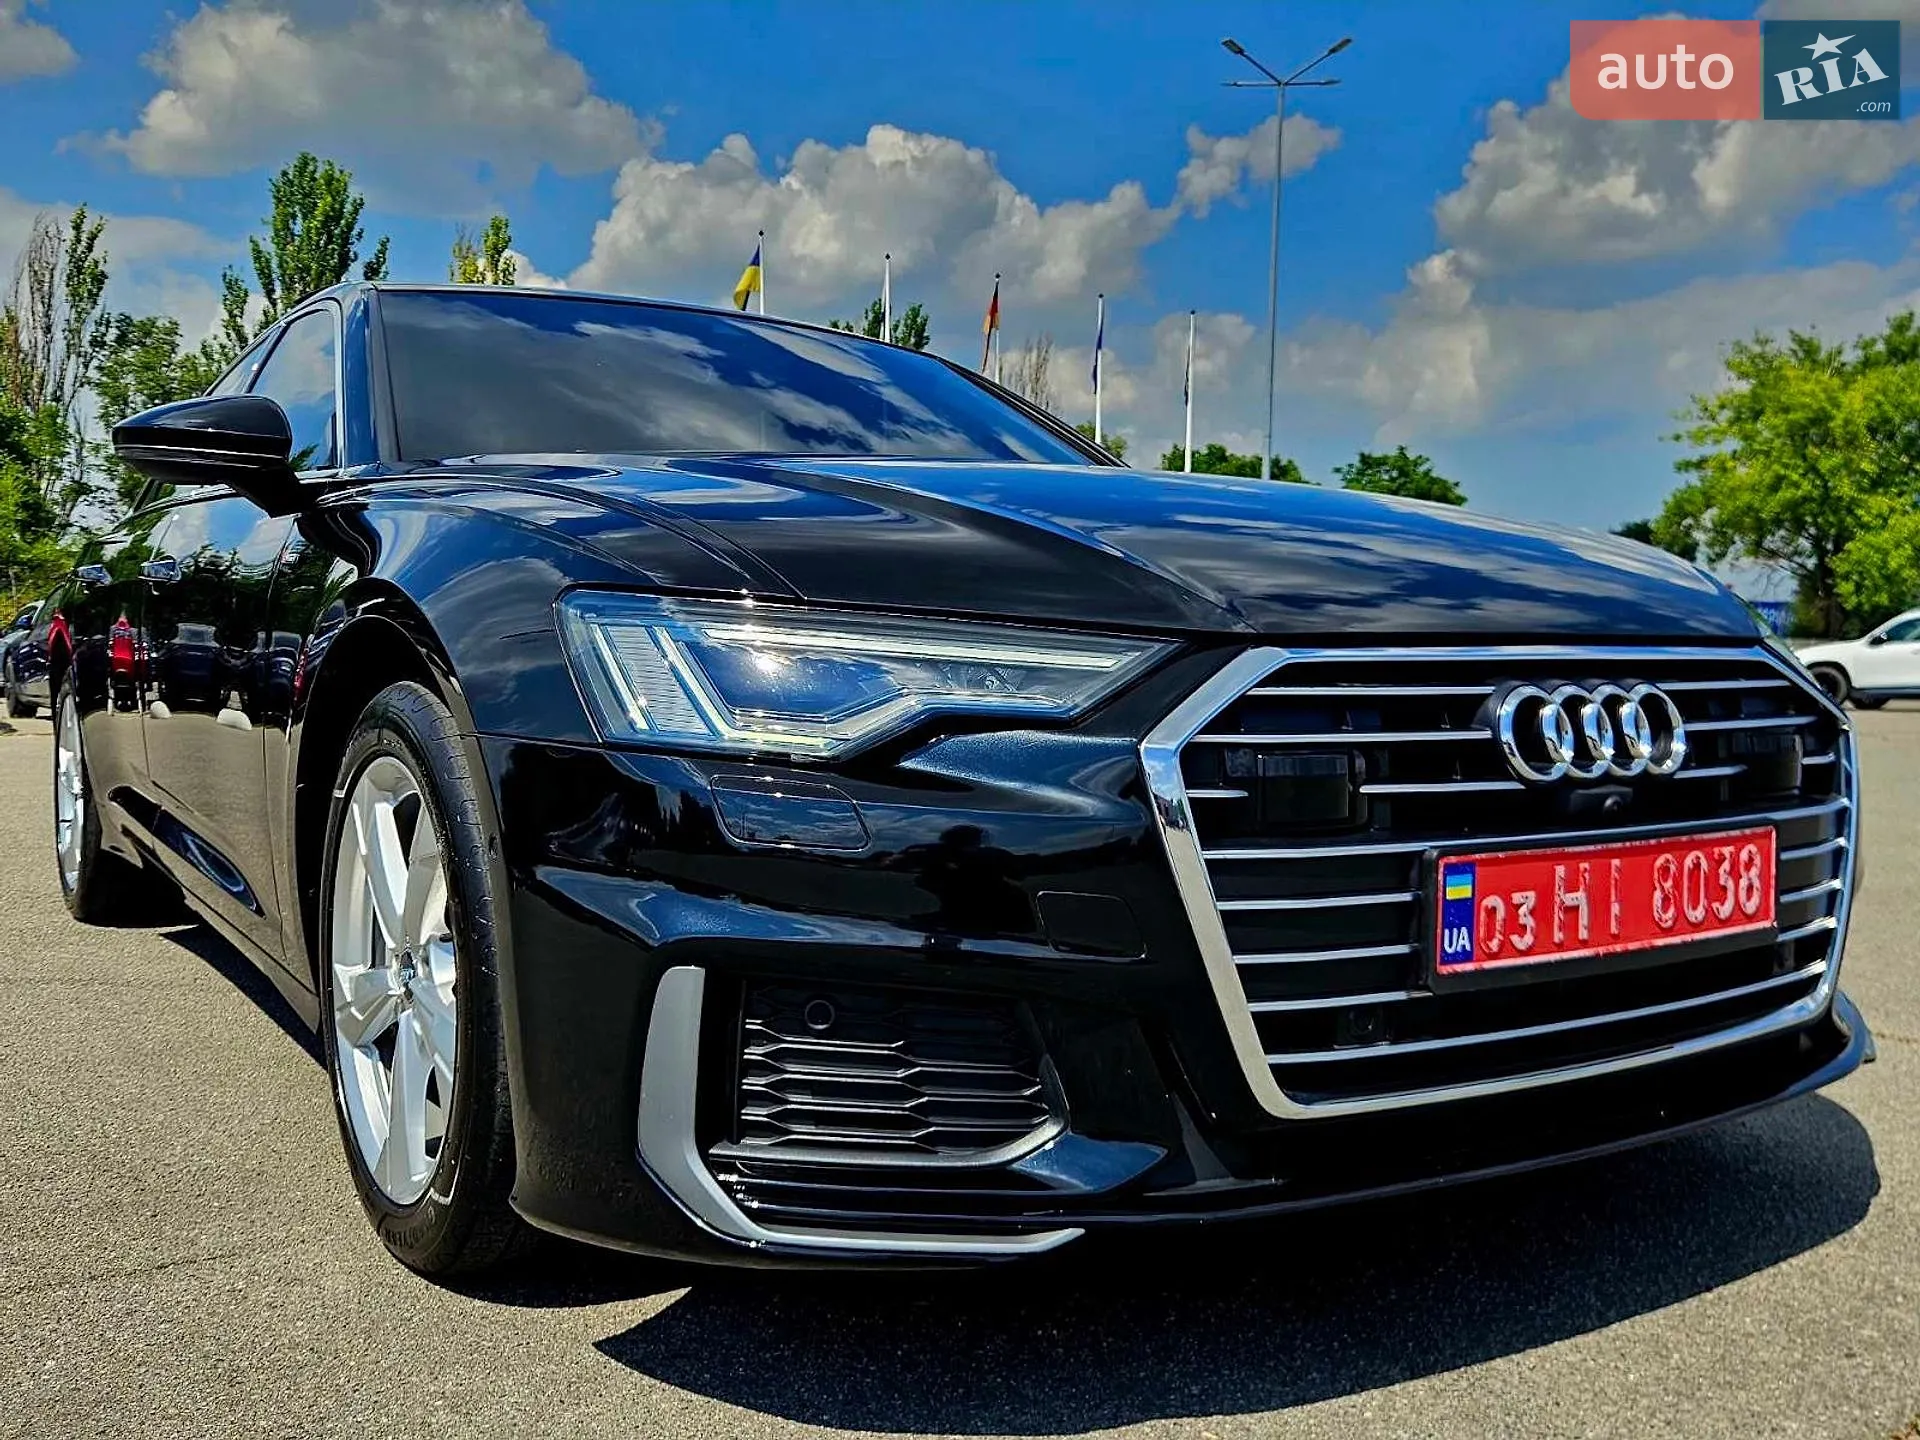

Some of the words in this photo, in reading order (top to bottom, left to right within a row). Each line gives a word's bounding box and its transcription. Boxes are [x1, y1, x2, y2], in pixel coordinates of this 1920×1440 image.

[1479, 894, 1537, 953] 03
[1652, 843, 1763, 929] 8038
[1443, 926, 1471, 953] UA
